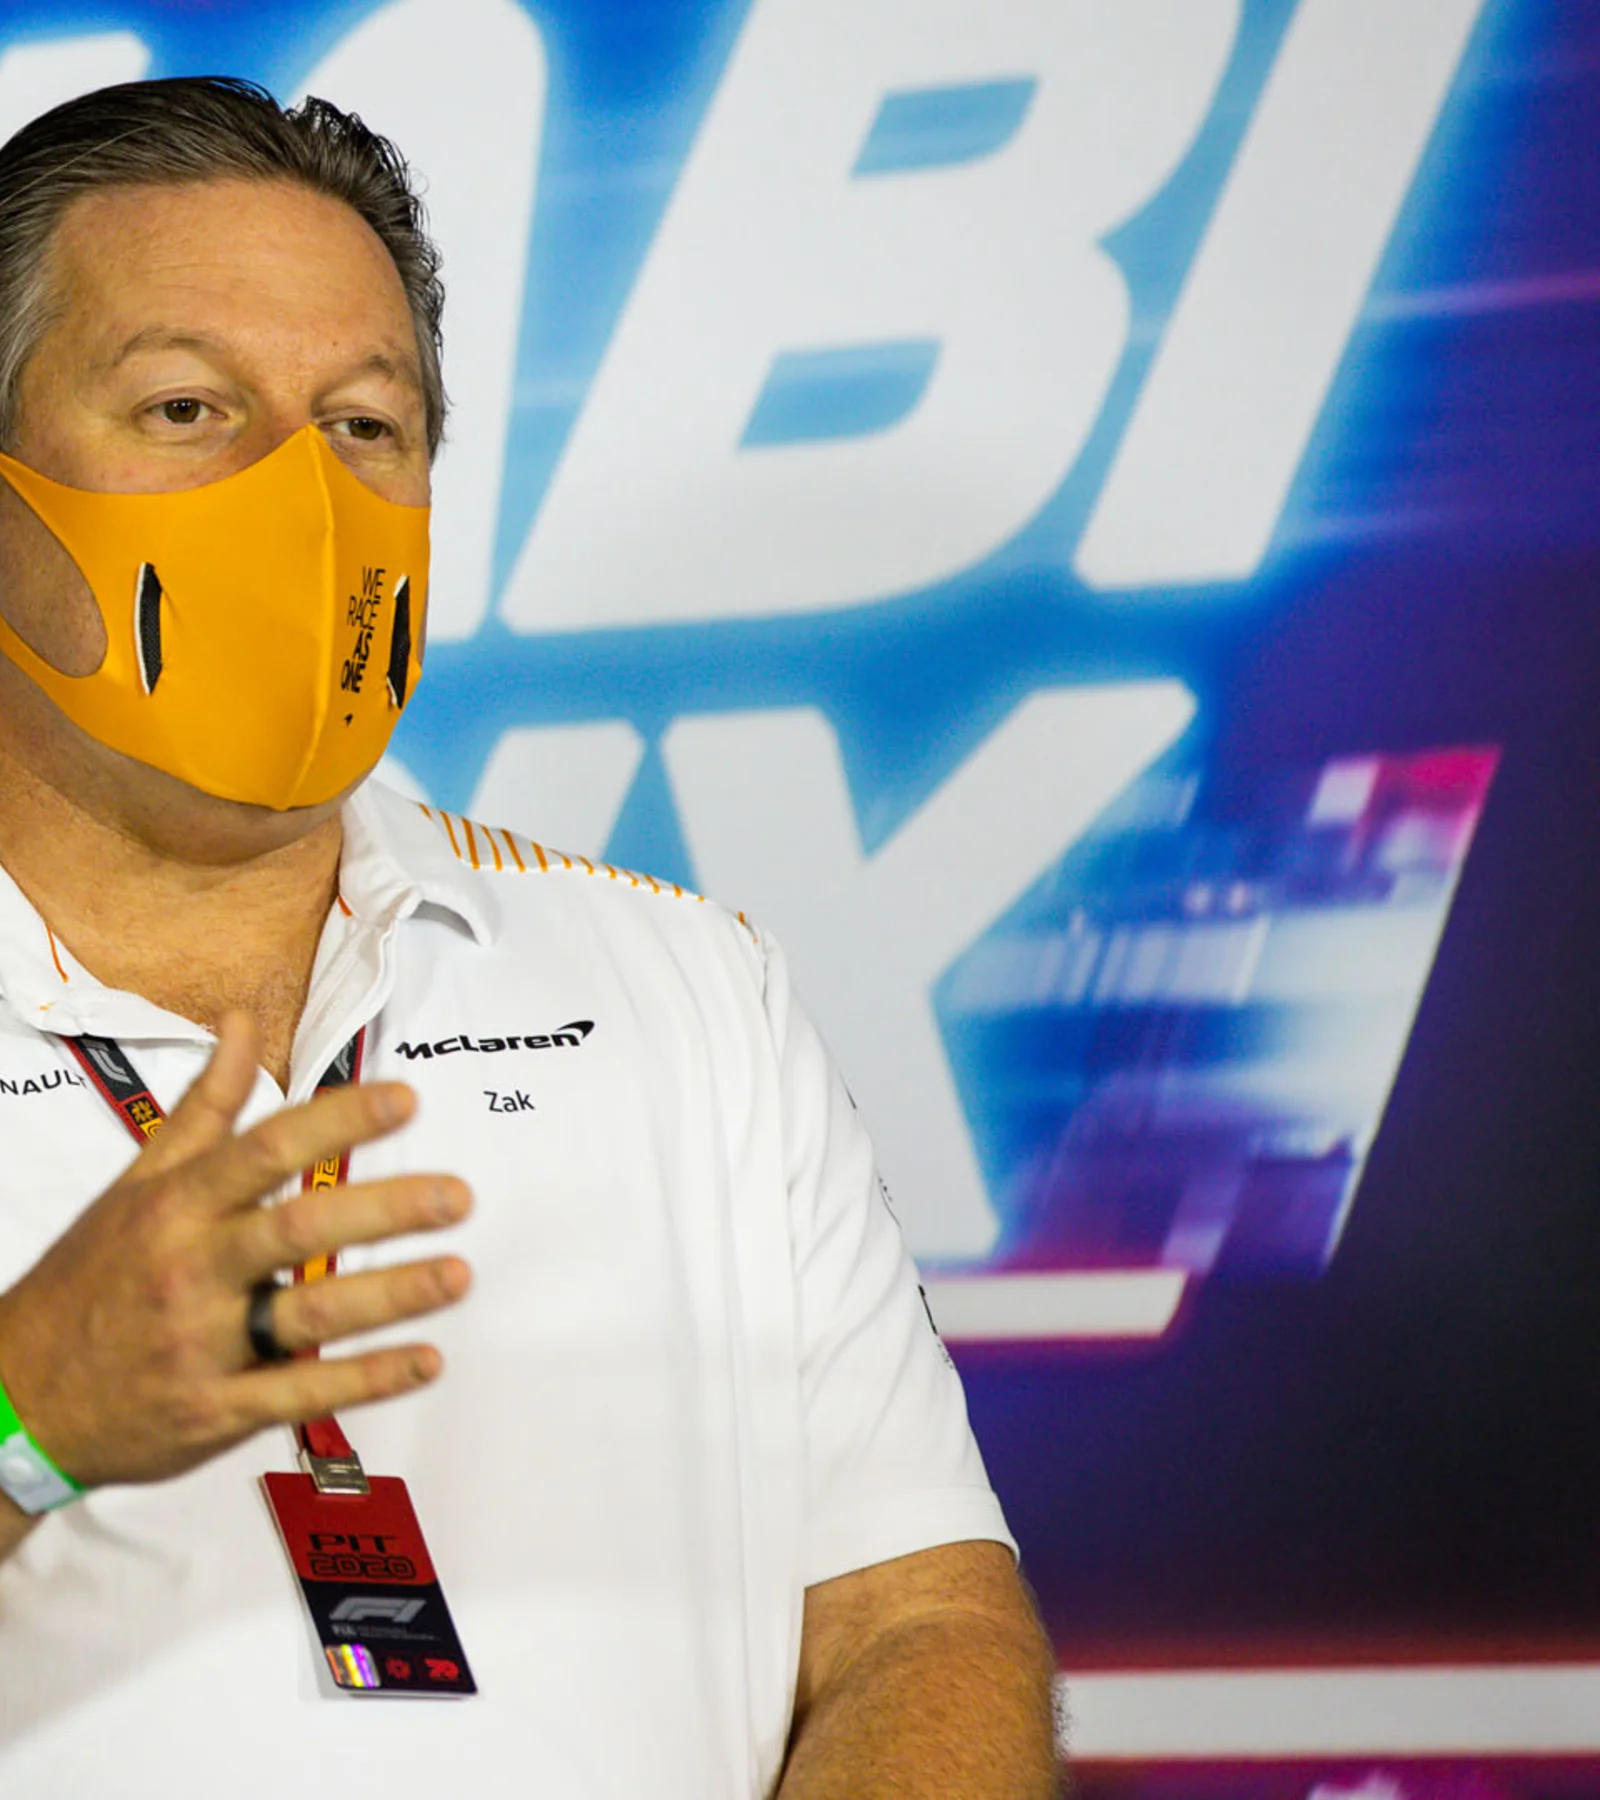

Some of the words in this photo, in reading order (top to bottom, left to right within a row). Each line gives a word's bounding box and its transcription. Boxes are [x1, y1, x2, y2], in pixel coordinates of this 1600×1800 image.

[362, 566, 386, 599] WE
[346, 595, 381, 631] RACE
[352, 630, 373, 661] AS
[340, 659, 366, 693] ONE
[483, 1089, 536, 1113] Zak
[308, 1533, 396, 1553] PIT
[306, 1552, 416, 1580] 2020
